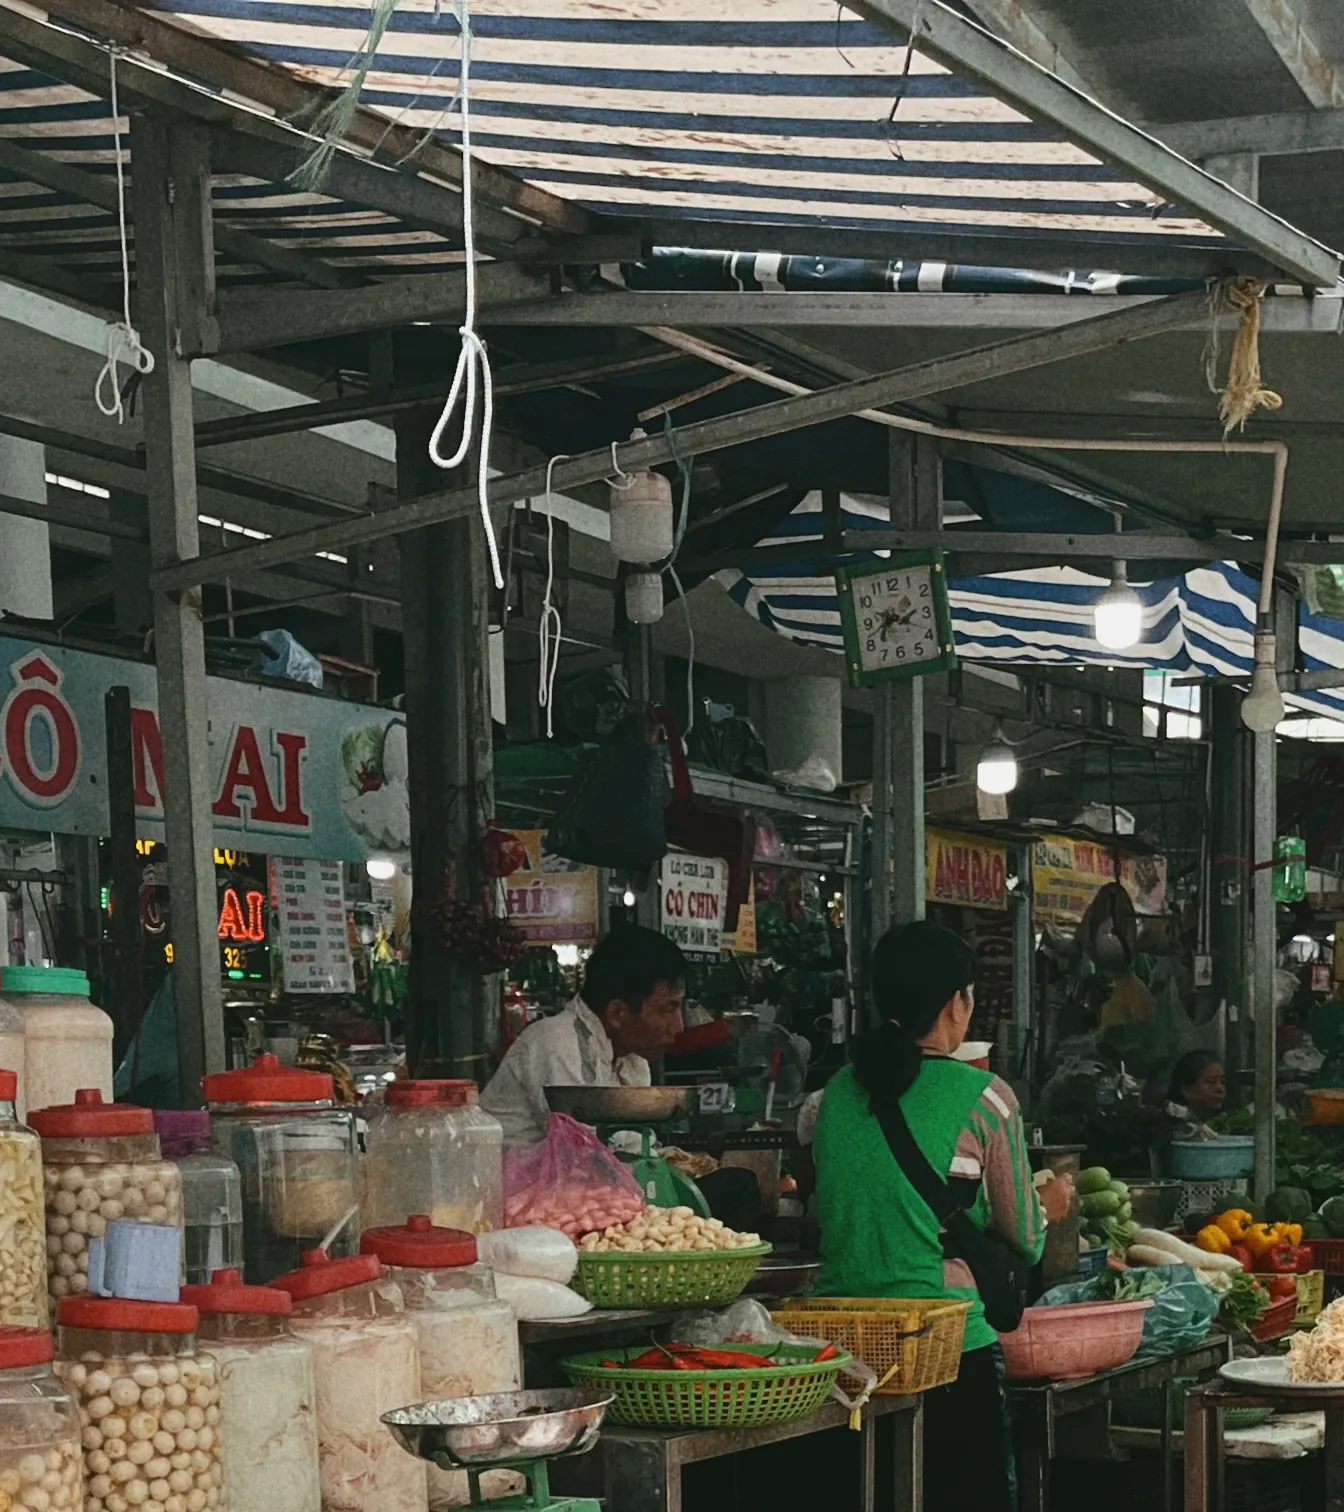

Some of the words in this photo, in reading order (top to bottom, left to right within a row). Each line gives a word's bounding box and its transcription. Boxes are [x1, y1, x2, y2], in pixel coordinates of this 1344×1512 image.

[871, 582, 881, 594] 11
[886, 578, 898, 591] 12
[918, 584, 929, 597] 2
[860, 596, 872, 608] 10
[922, 606, 931, 619] 3
[863, 618, 872, 630] 9
[924, 628, 934, 640] 4
[866, 640, 876, 652] 8
[895, 646, 906, 658] 6
[914, 642, 924, 656] 5
[880, 649, 888, 661] 7
